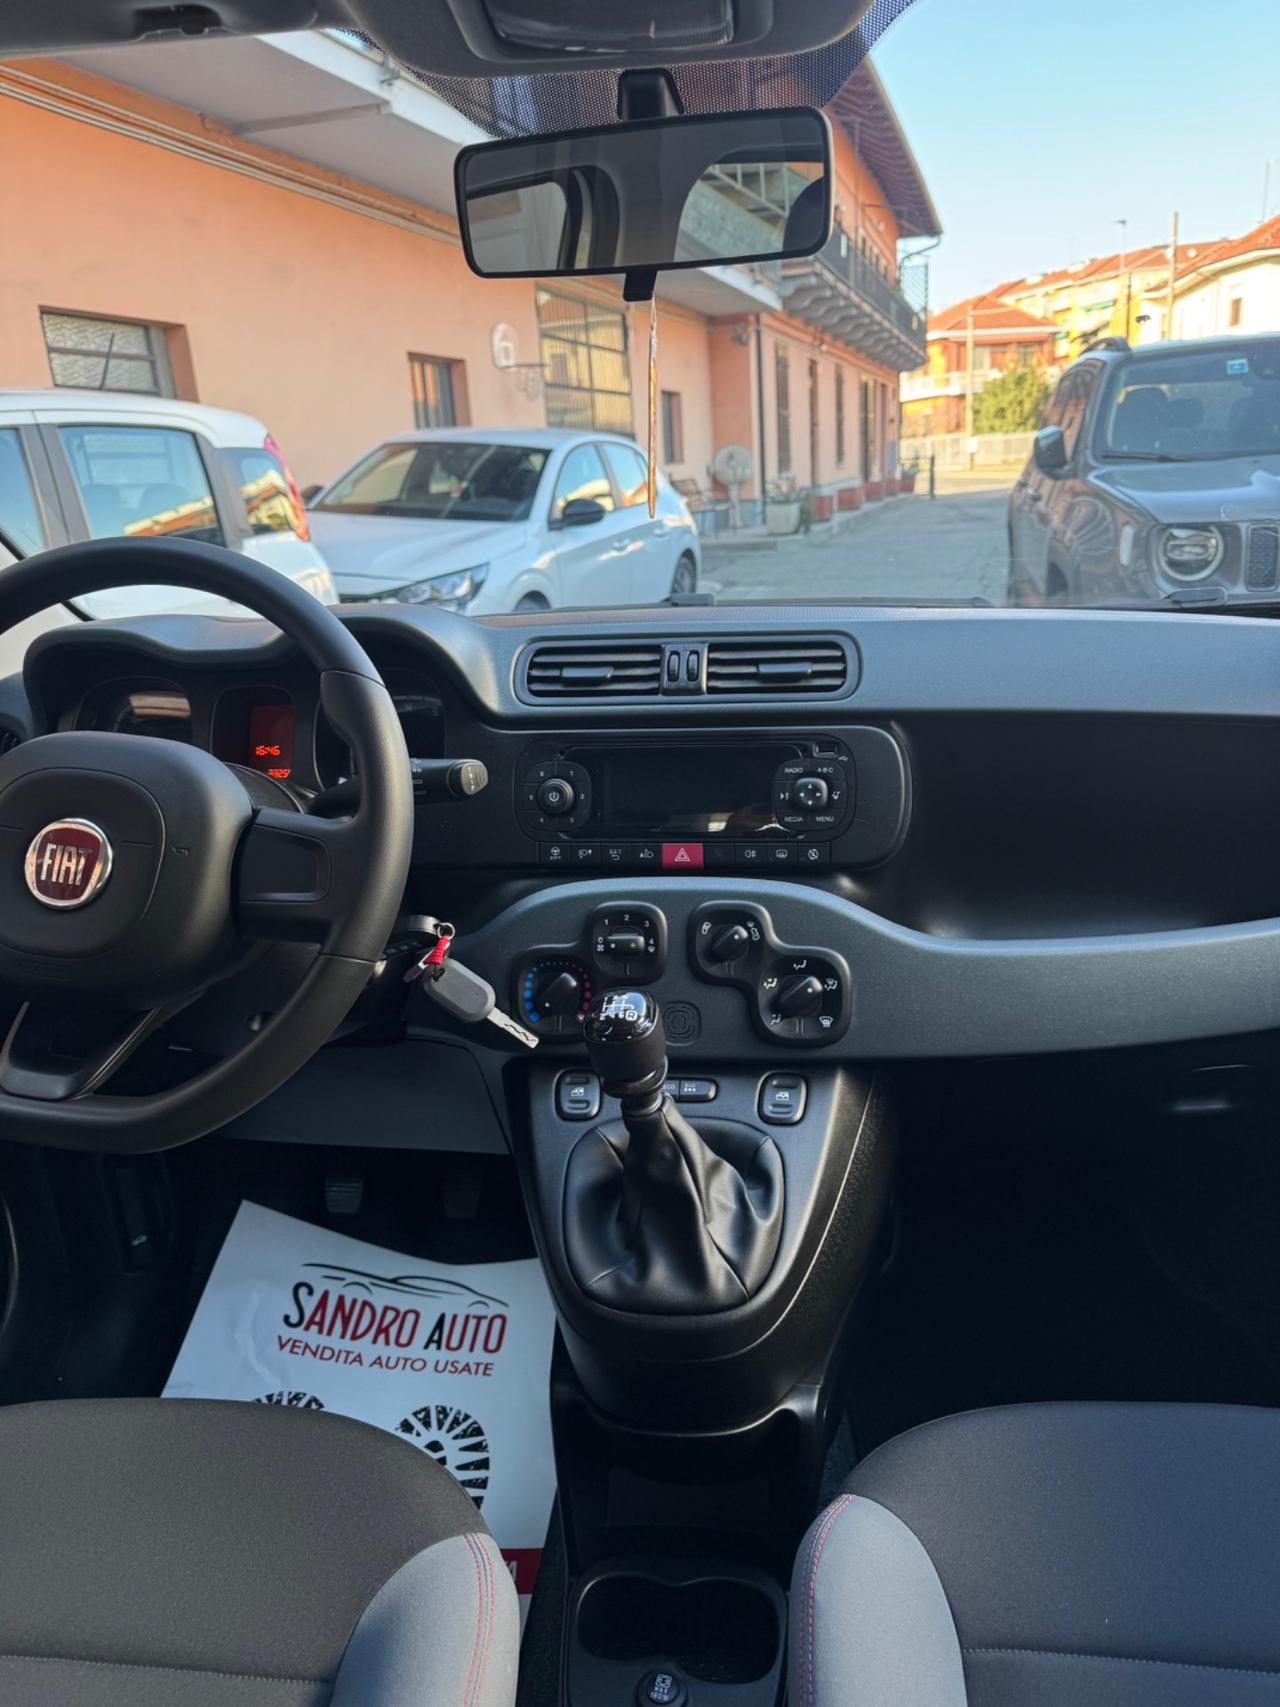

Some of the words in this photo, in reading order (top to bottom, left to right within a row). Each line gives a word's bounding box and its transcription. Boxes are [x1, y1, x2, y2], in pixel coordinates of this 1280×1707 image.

[40, 842, 93, 886] FIAT
[643, 920, 650, 928] 3
[282, 1281, 421, 1348] SANDRO
[423, 1311, 508, 1354] AUTO
[277, 1334, 364, 1367] VENDITA
[368, 1354, 428, 1373] AUTO
[433, 1359, 495, 1377] USATE
